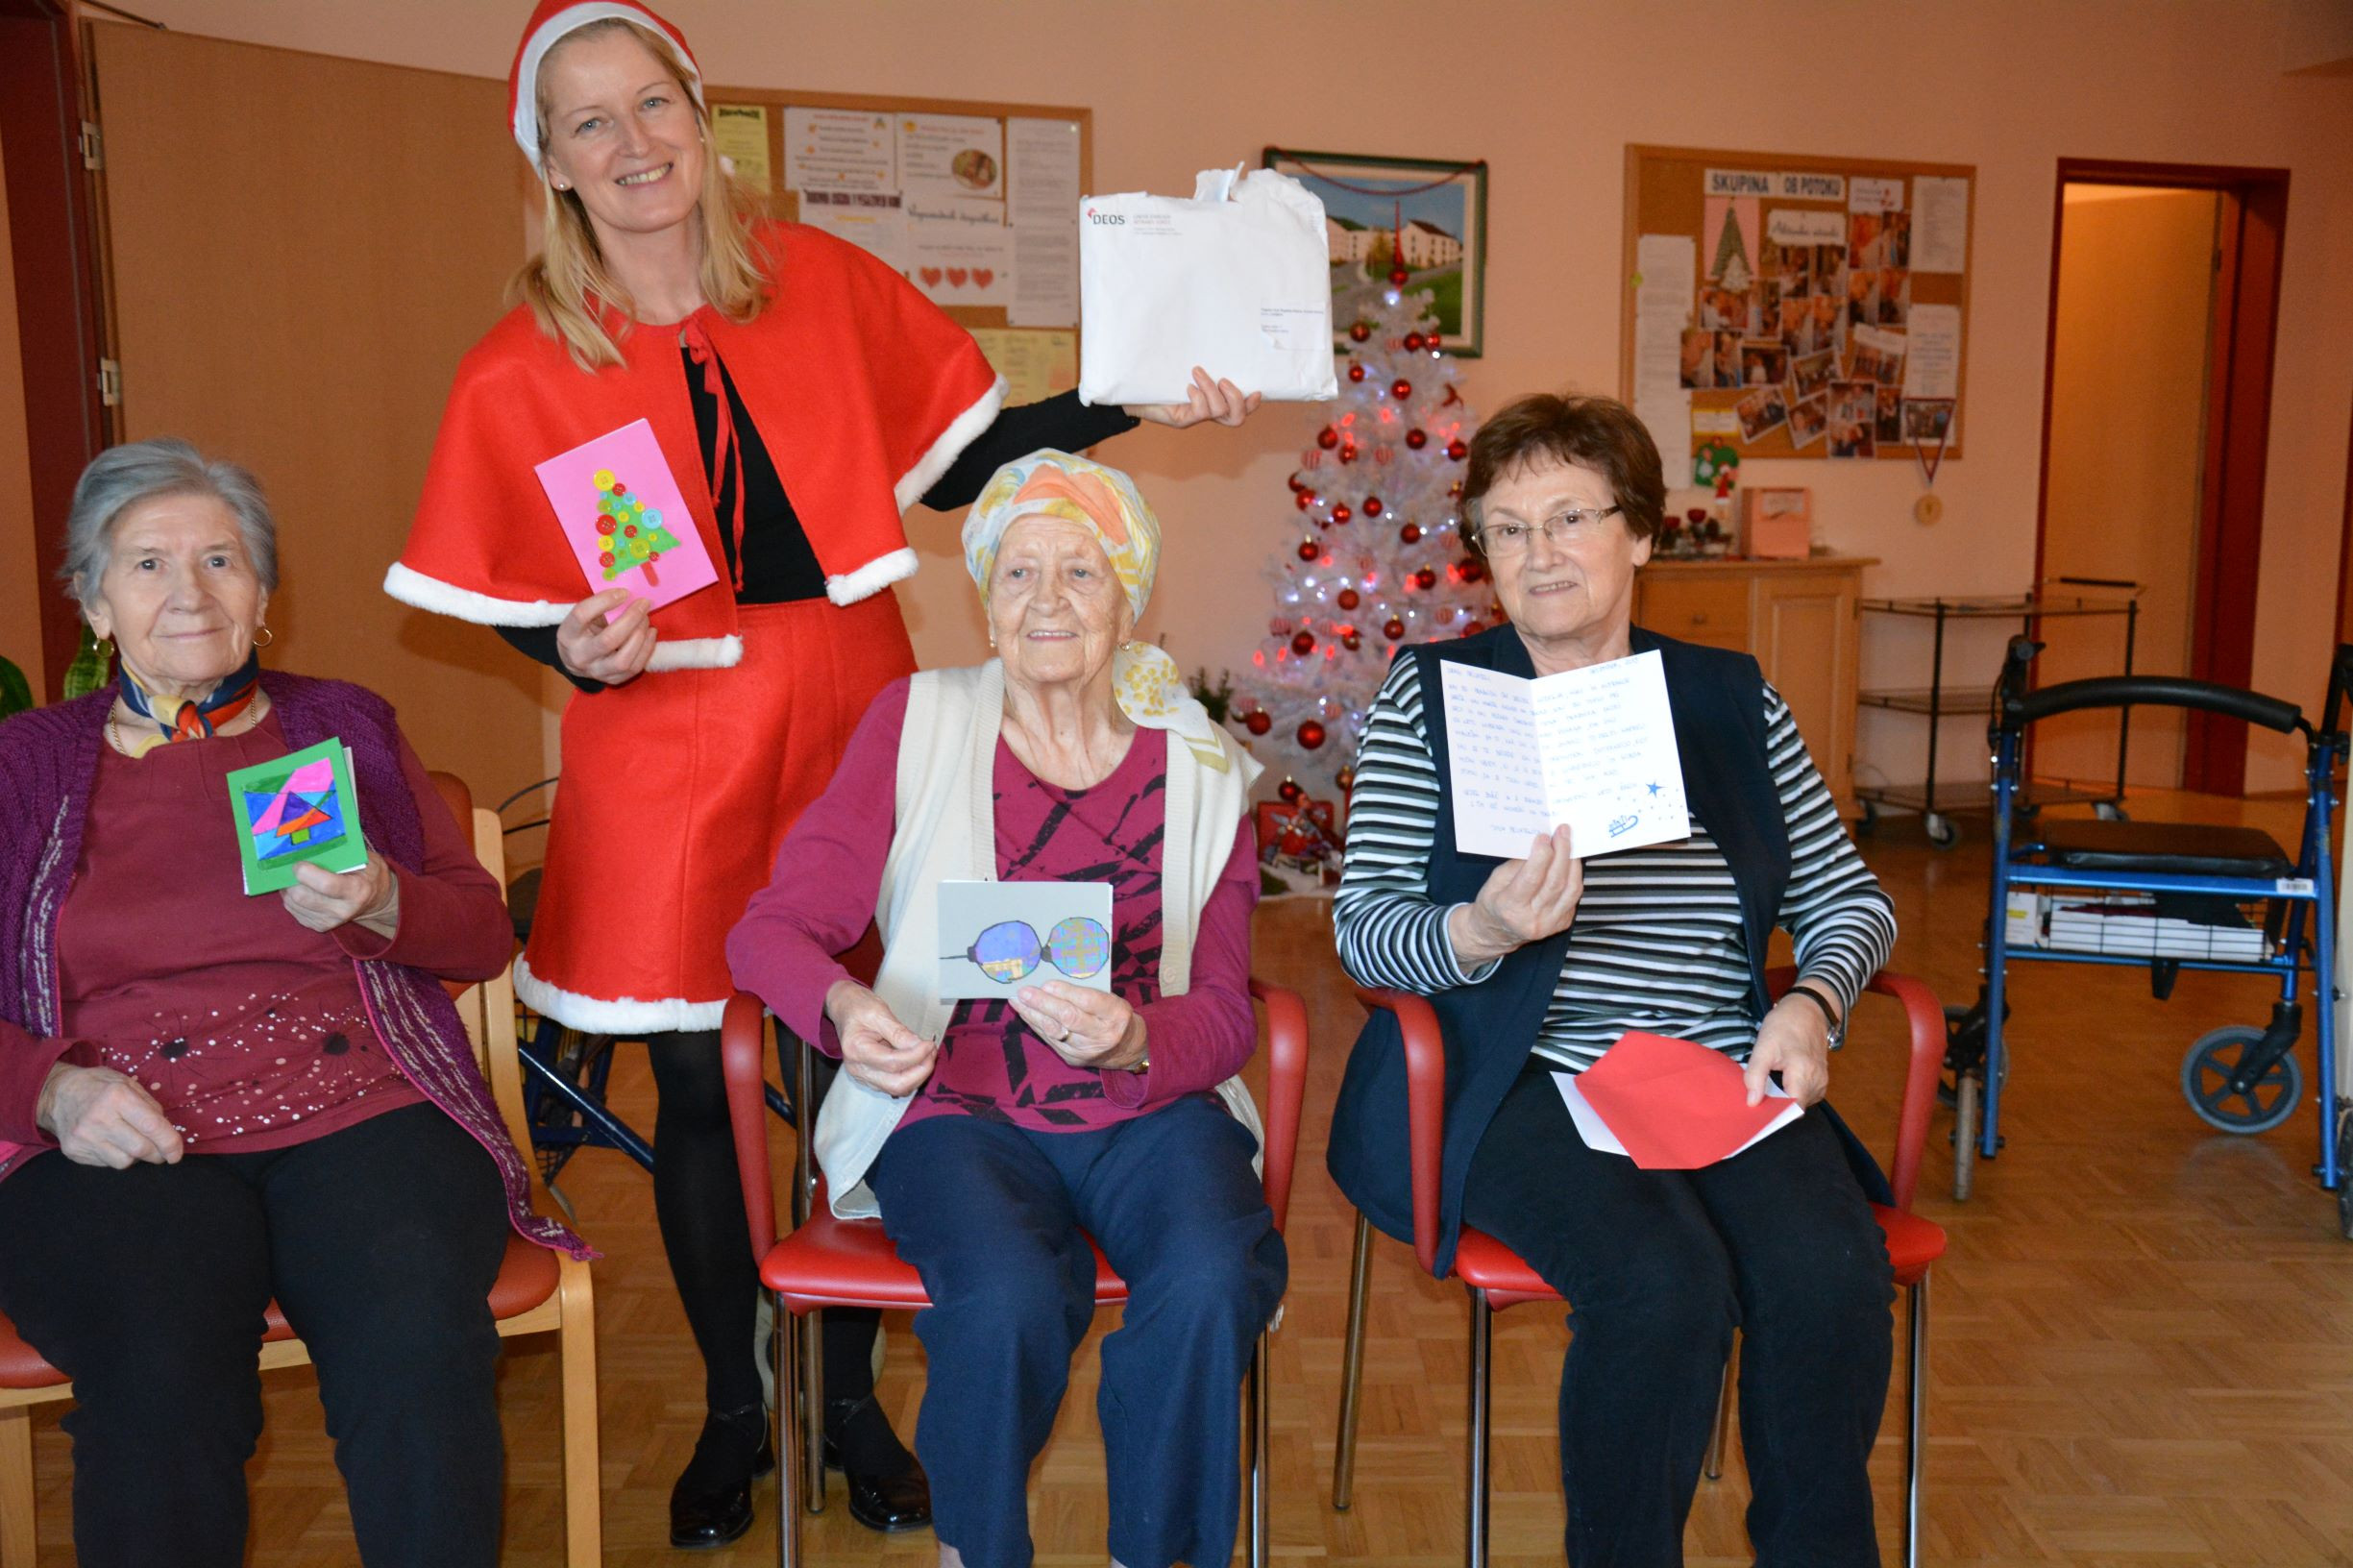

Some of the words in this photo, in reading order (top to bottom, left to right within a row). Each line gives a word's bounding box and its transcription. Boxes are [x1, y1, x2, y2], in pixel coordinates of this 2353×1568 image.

[1713, 173, 1769, 193] SKUPINA
[1802, 177, 1841, 196] POTOKU
[1093, 214, 1125, 225] DEOS
